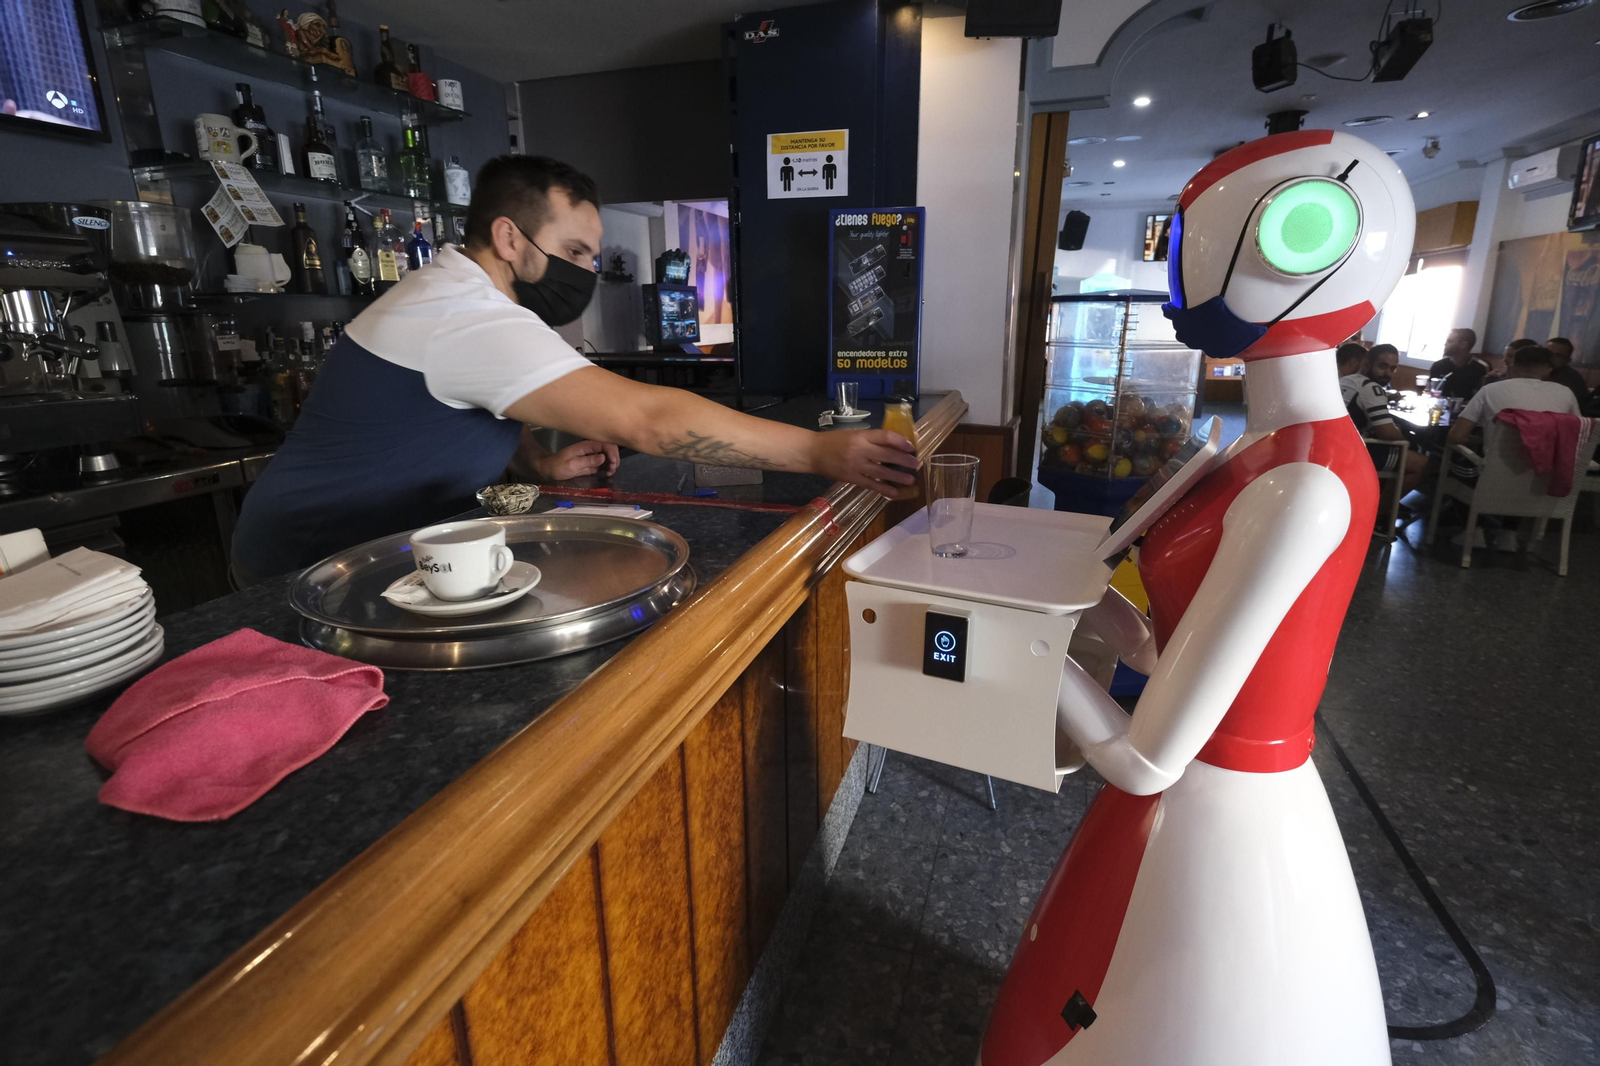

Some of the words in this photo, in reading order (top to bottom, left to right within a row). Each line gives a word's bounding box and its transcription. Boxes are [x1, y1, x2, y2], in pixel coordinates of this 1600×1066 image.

[835, 213, 869, 227] ¿tienes
[871, 212, 903, 228] fuego?
[837, 350, 886, 358] encendedores
[888, 349, 908, 358] extra
[836, 358, 852, 369] 50
[855, 357, 908, 369] modelos
[933, 651, 957, 664] EXIT
